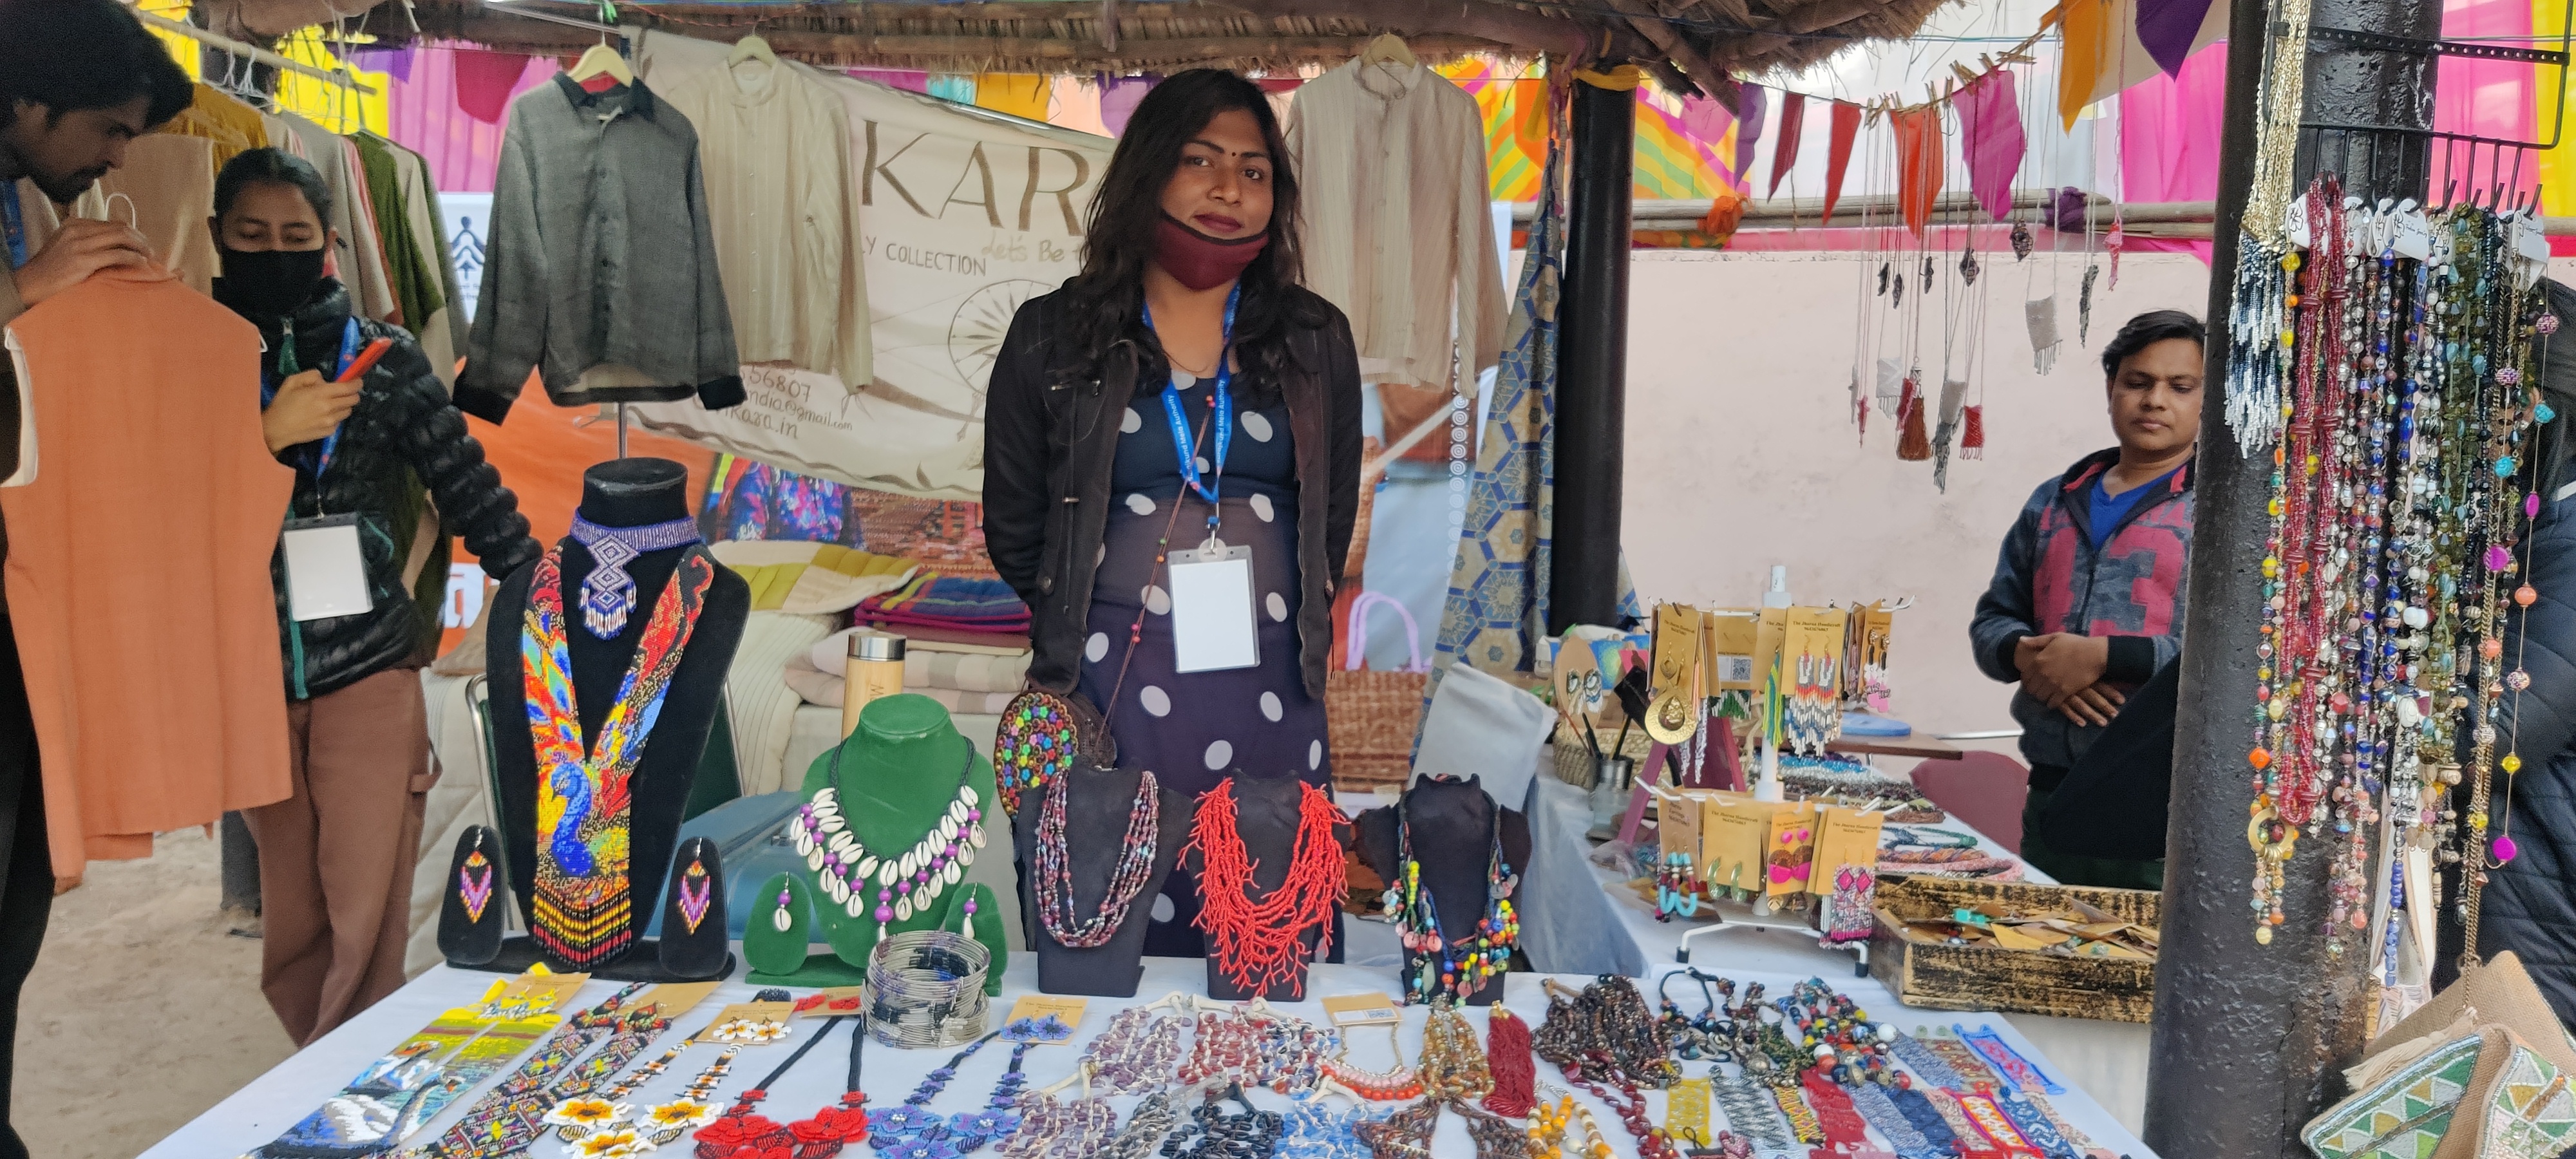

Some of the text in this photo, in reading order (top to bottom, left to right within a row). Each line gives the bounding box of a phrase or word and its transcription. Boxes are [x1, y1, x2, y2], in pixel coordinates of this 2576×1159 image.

[862, 118, 1090, 237] KAR
[886, 243, 987, 276] COLLECTION
[741, 365, 811, 402] 56807
[1168, 395, 1182, 426] Authority
